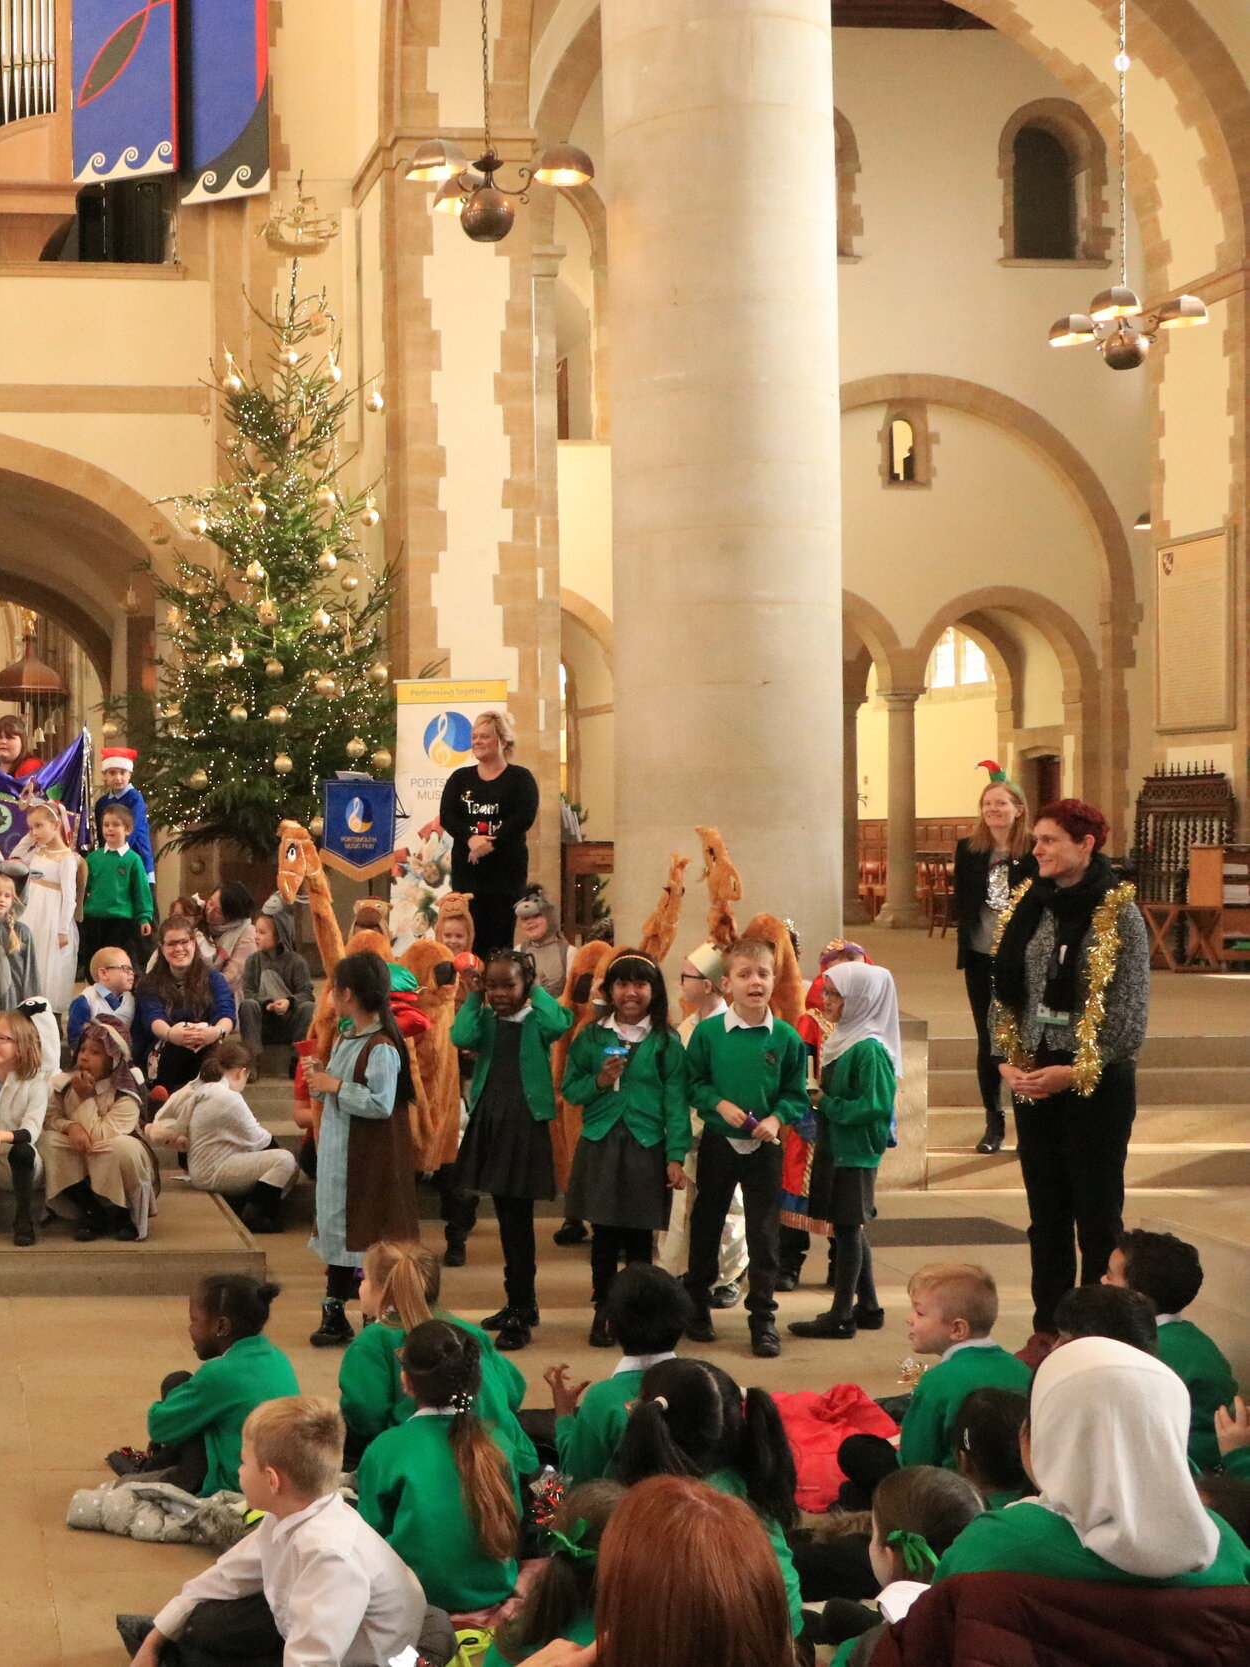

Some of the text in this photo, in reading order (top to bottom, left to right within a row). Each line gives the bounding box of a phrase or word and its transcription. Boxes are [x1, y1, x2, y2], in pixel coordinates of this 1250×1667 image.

[410, 687, 487, 697] Performing together
[410, 777, 448, 788] PORTS
[417, 790, 441, 801] MUS
[463, 800, 499, 815] Team
